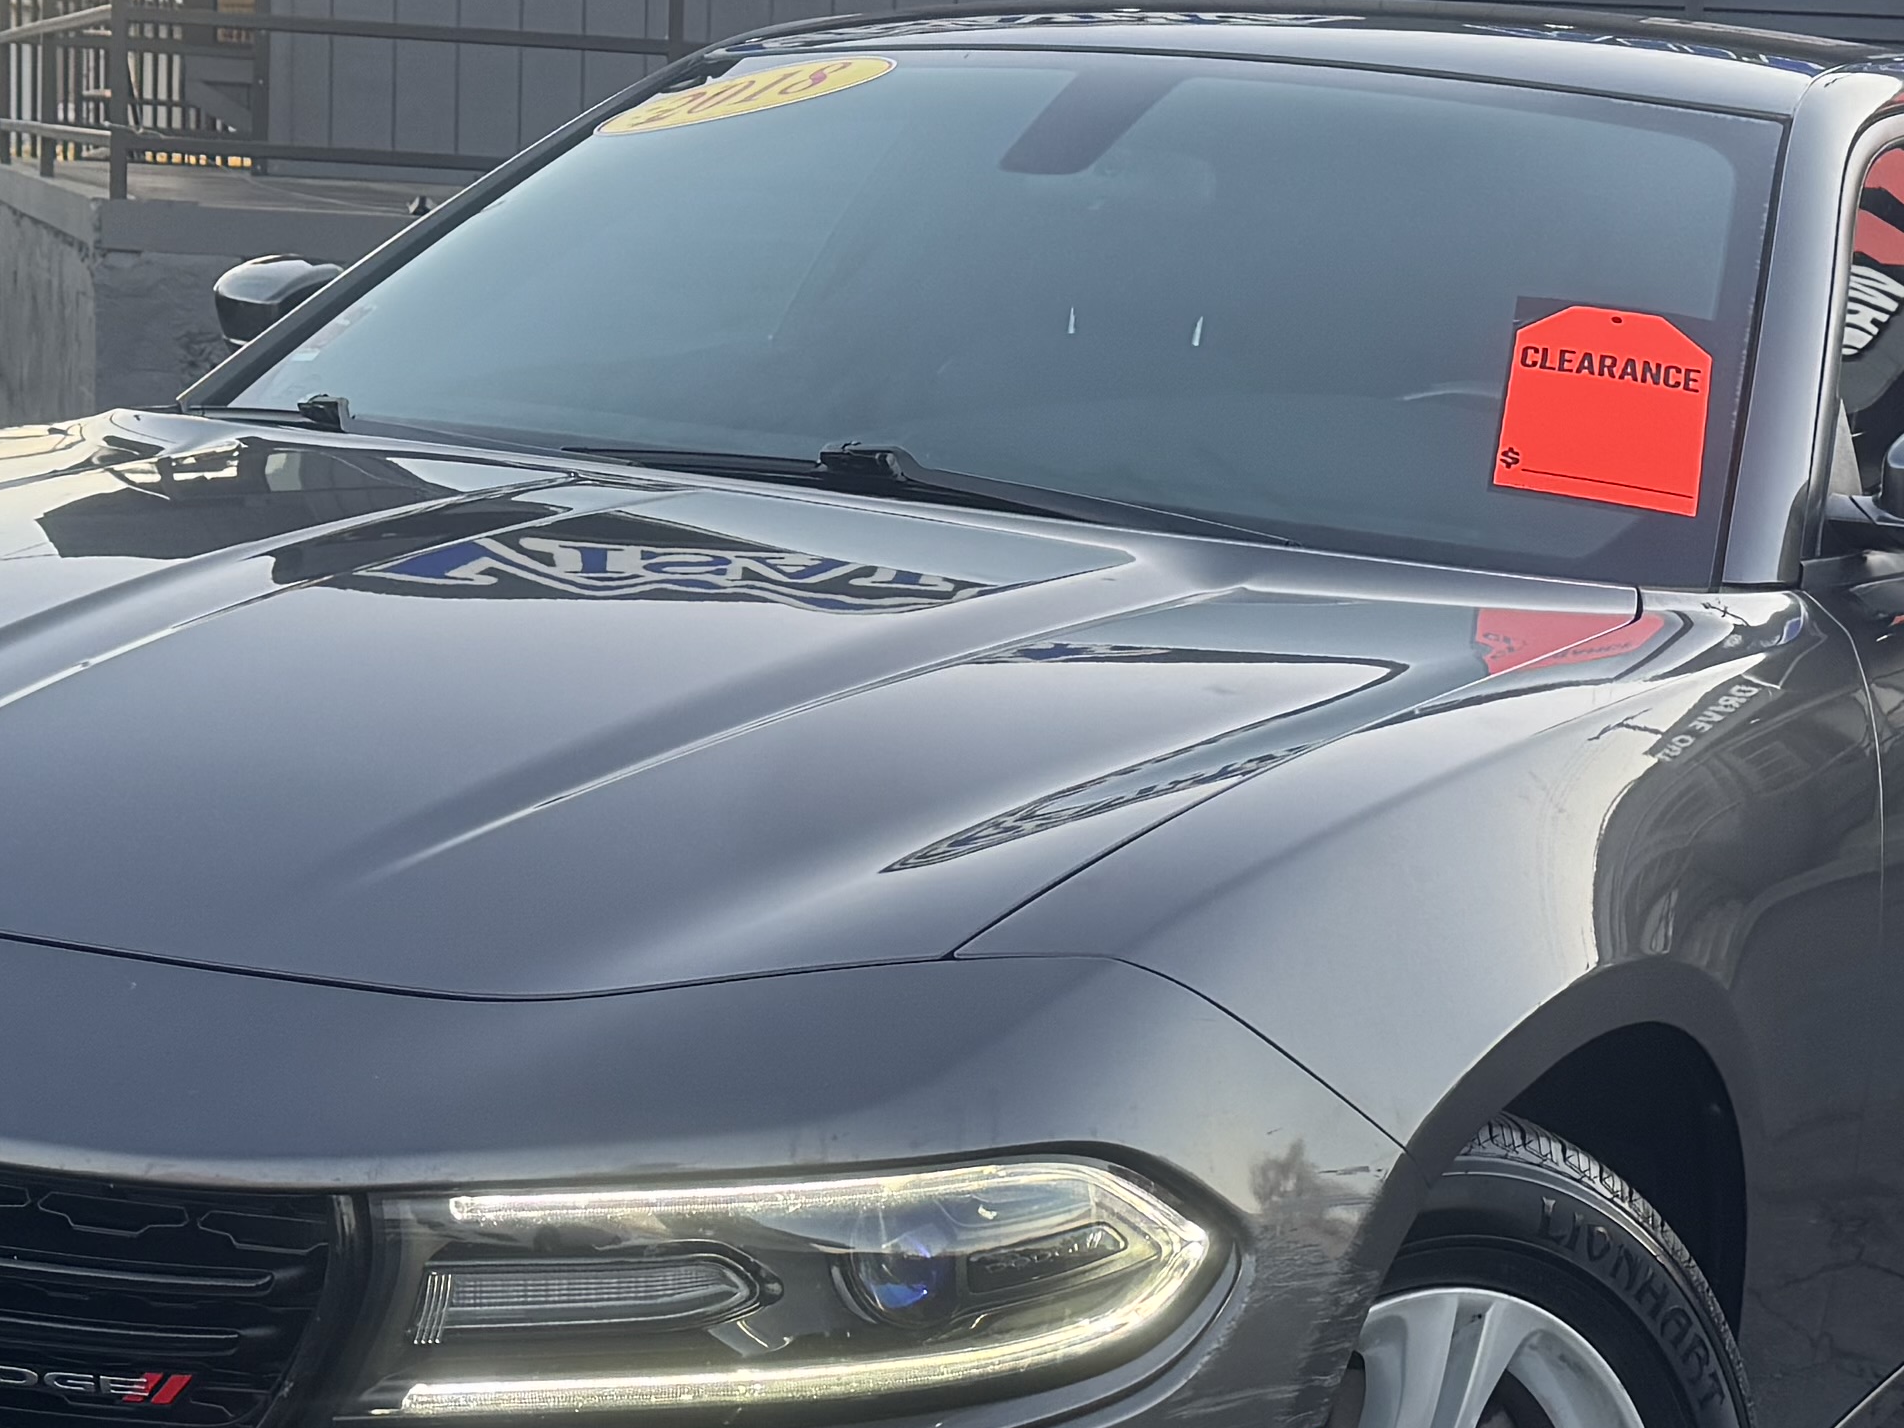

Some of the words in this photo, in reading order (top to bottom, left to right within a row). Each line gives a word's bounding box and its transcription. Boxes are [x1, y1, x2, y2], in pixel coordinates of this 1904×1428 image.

[629, 61, 853, 128] 2018
[1519, 345, 1702, 393] CLEARANCE
[1499, 446, 1521, 469] $
[1539, 1195, 1726, 1407] LIONHART
